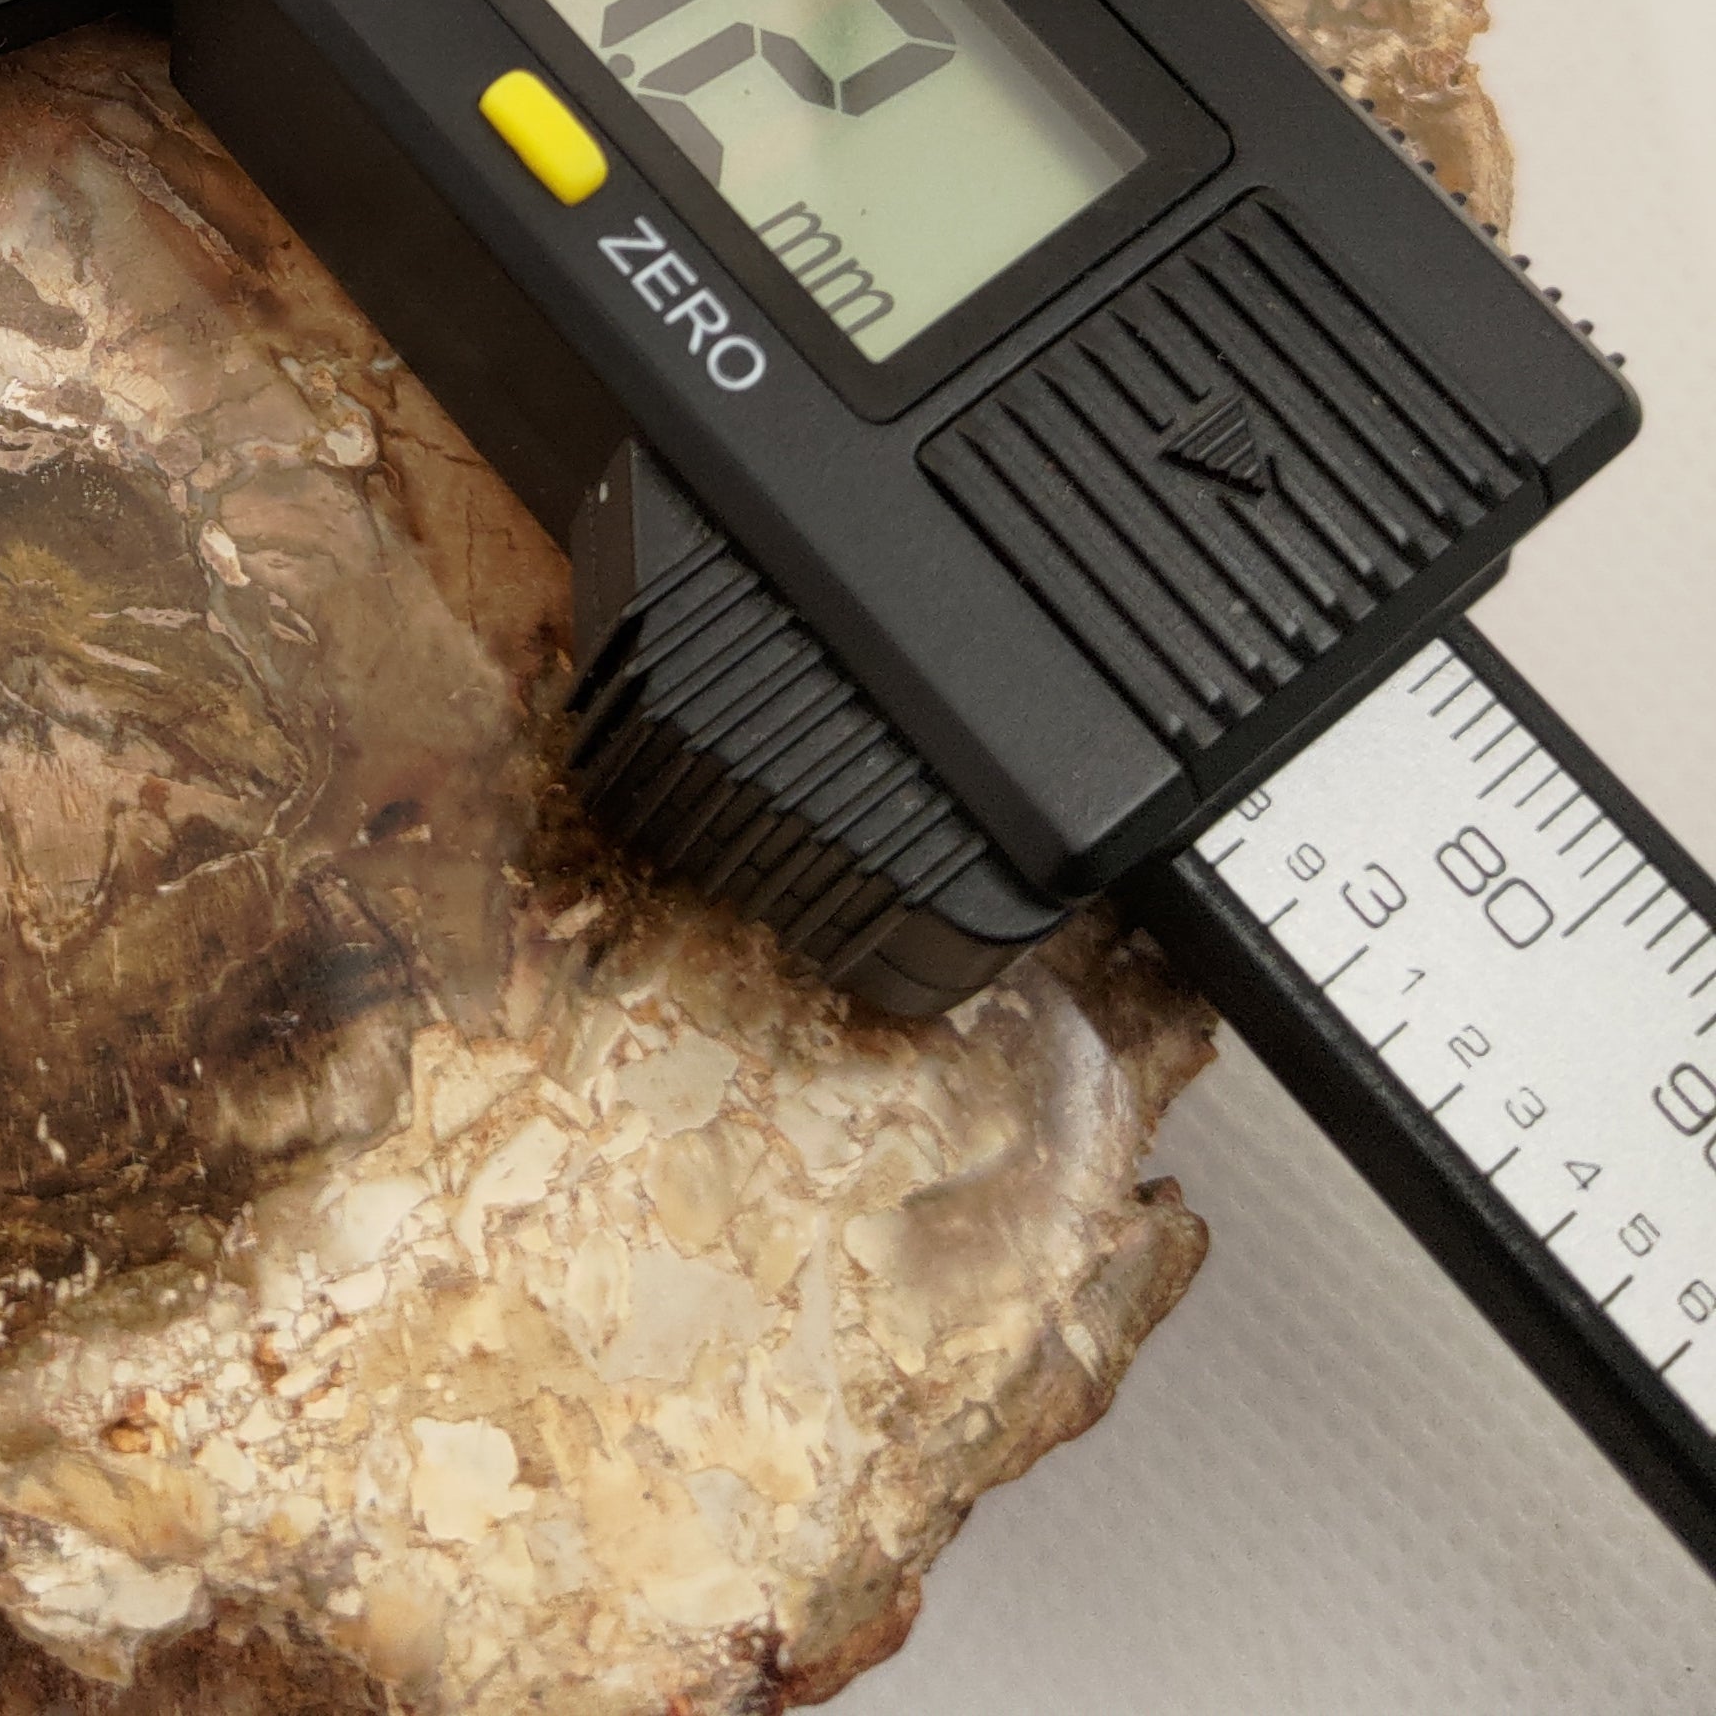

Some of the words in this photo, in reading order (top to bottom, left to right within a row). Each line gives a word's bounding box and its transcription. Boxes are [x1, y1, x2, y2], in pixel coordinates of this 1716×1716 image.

[597, 215, 768, 393] ZERO
[760, 199, 896, 336] mm
[1285, 842, 1327, 882] 9
[1339, 861, 1408, 930] 3
[1401, 969, 1425, 993] 1
[1447, 1025, 1492, 1069] 2
[1504, 1086, 1548, 1130] 3
[1563, 1159, 1603, 1191] 4
[1618, 1212, 1661, 1258] 5
[1434, 825, 1555, 950] 80
[1652, 1063, 1716, 1176] 9
